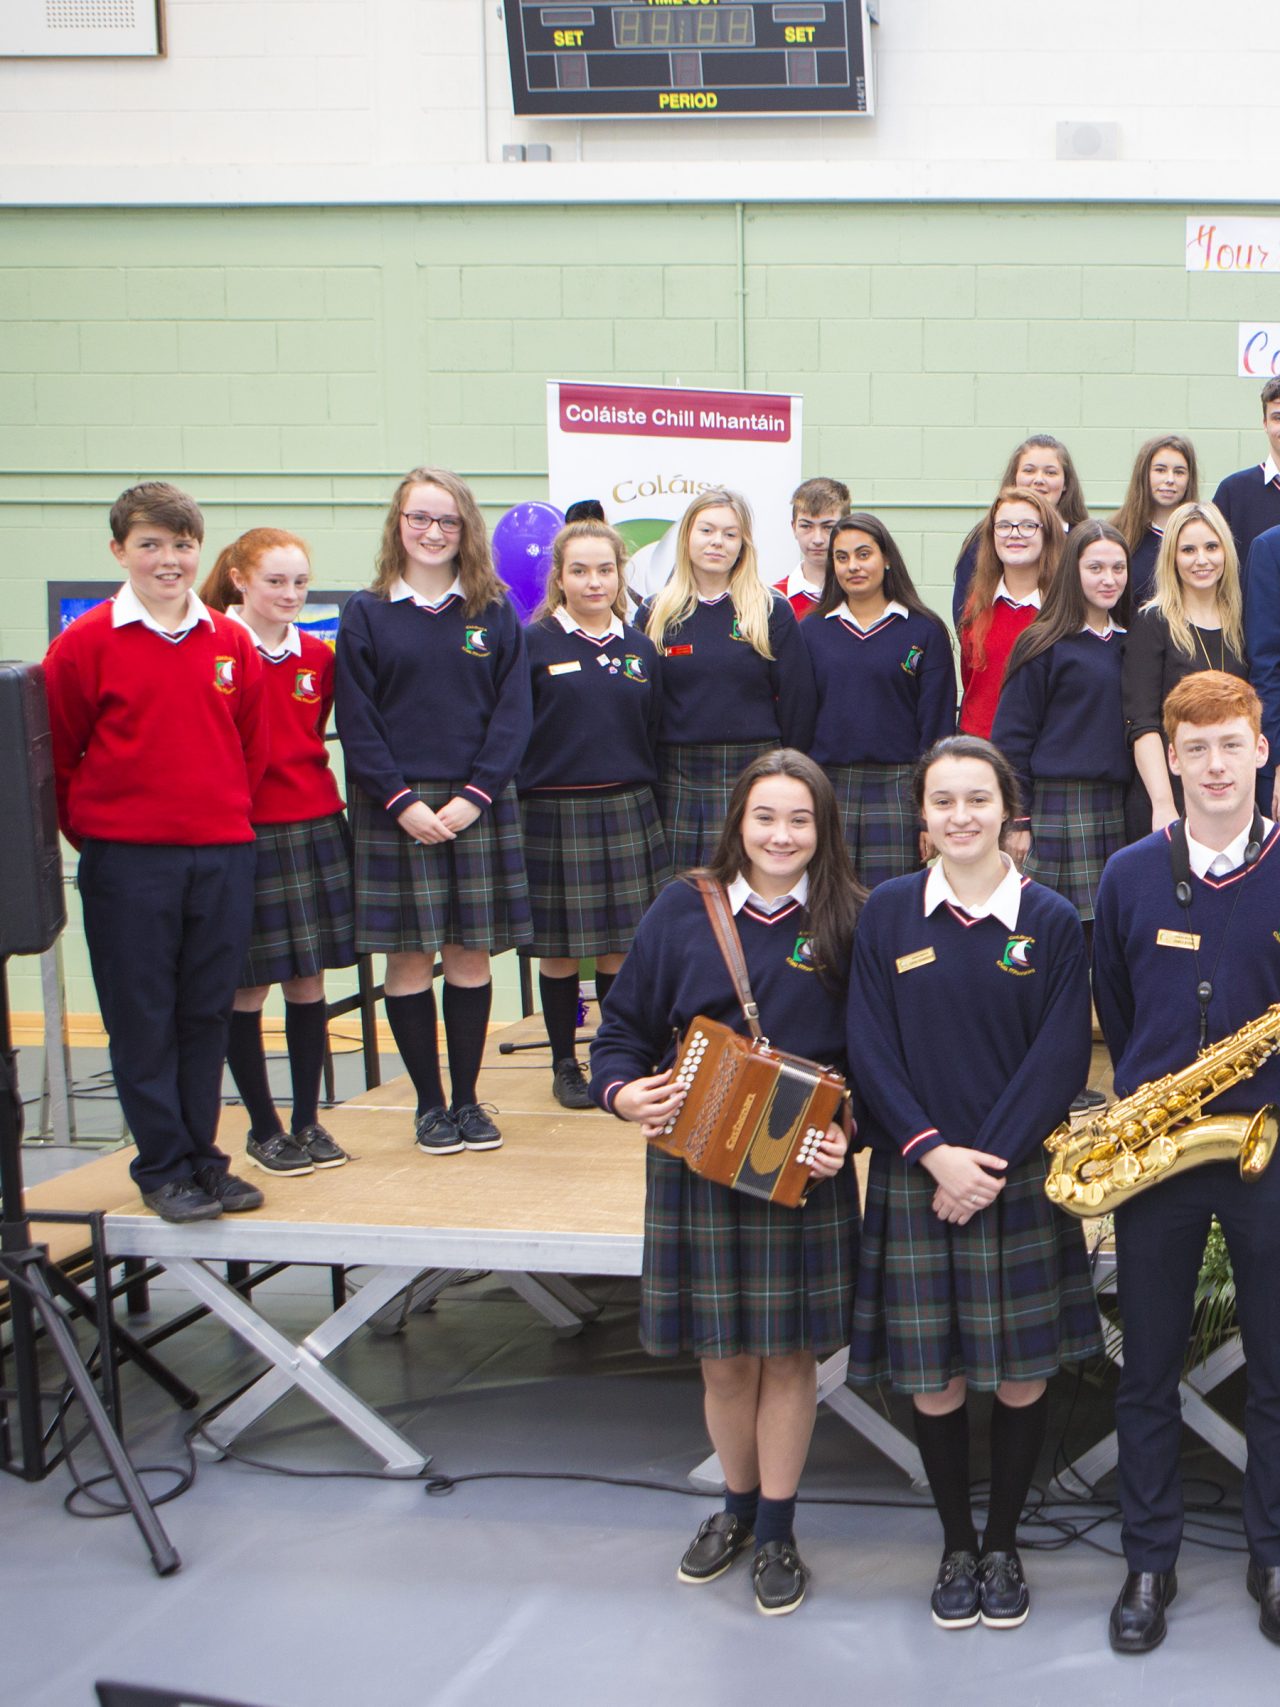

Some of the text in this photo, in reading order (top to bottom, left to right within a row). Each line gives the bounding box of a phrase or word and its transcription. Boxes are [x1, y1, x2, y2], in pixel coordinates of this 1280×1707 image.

[554, 31, 584, 46] SET
[785, 27, 816, 43] SET
[659, 94, 718, 109] PERIOD
[1187, 224, 1269, 270] Your
[565, 404, 785, 432] Coláiste Chill Mhantáin
